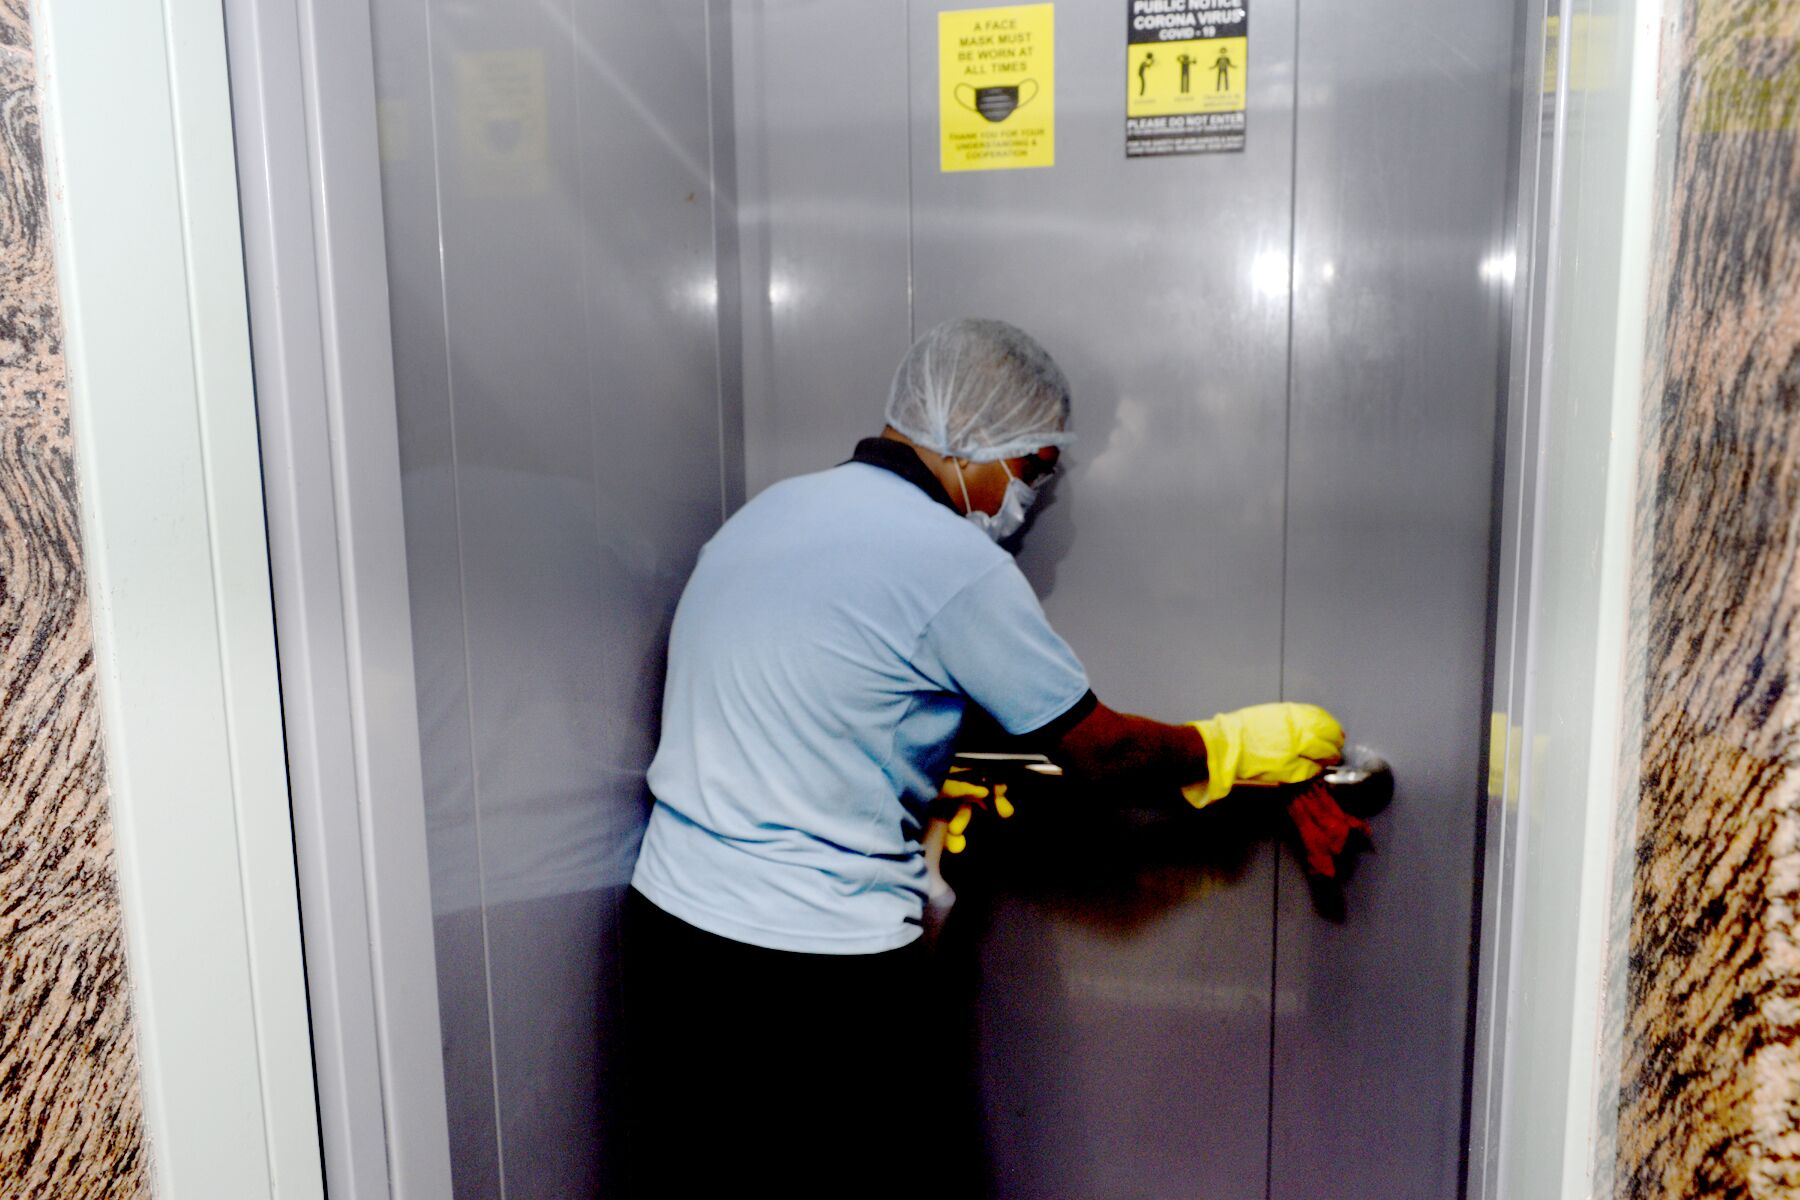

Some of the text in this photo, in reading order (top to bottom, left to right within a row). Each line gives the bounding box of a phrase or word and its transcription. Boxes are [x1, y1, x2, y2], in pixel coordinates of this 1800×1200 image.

[1134, 0, 1241, 14] PUBLIC NOTICE
[974, 19, 1017, 31] A FACE
[1134, 8, 1242, 30] CORONA VIRUS
[959, 32, 1032, 47] MASK MUST
[1159, 26, 1194, 40] COVID
[958, 46, 1033, 61] BE WORN AT
[964, 60, 1027, 76] ALL TIMES
[1127, 116, 1168, 129] PLEASE
[1168, 115, 1186, 127] DO
[1186, 113, 1209, 126] NOT
